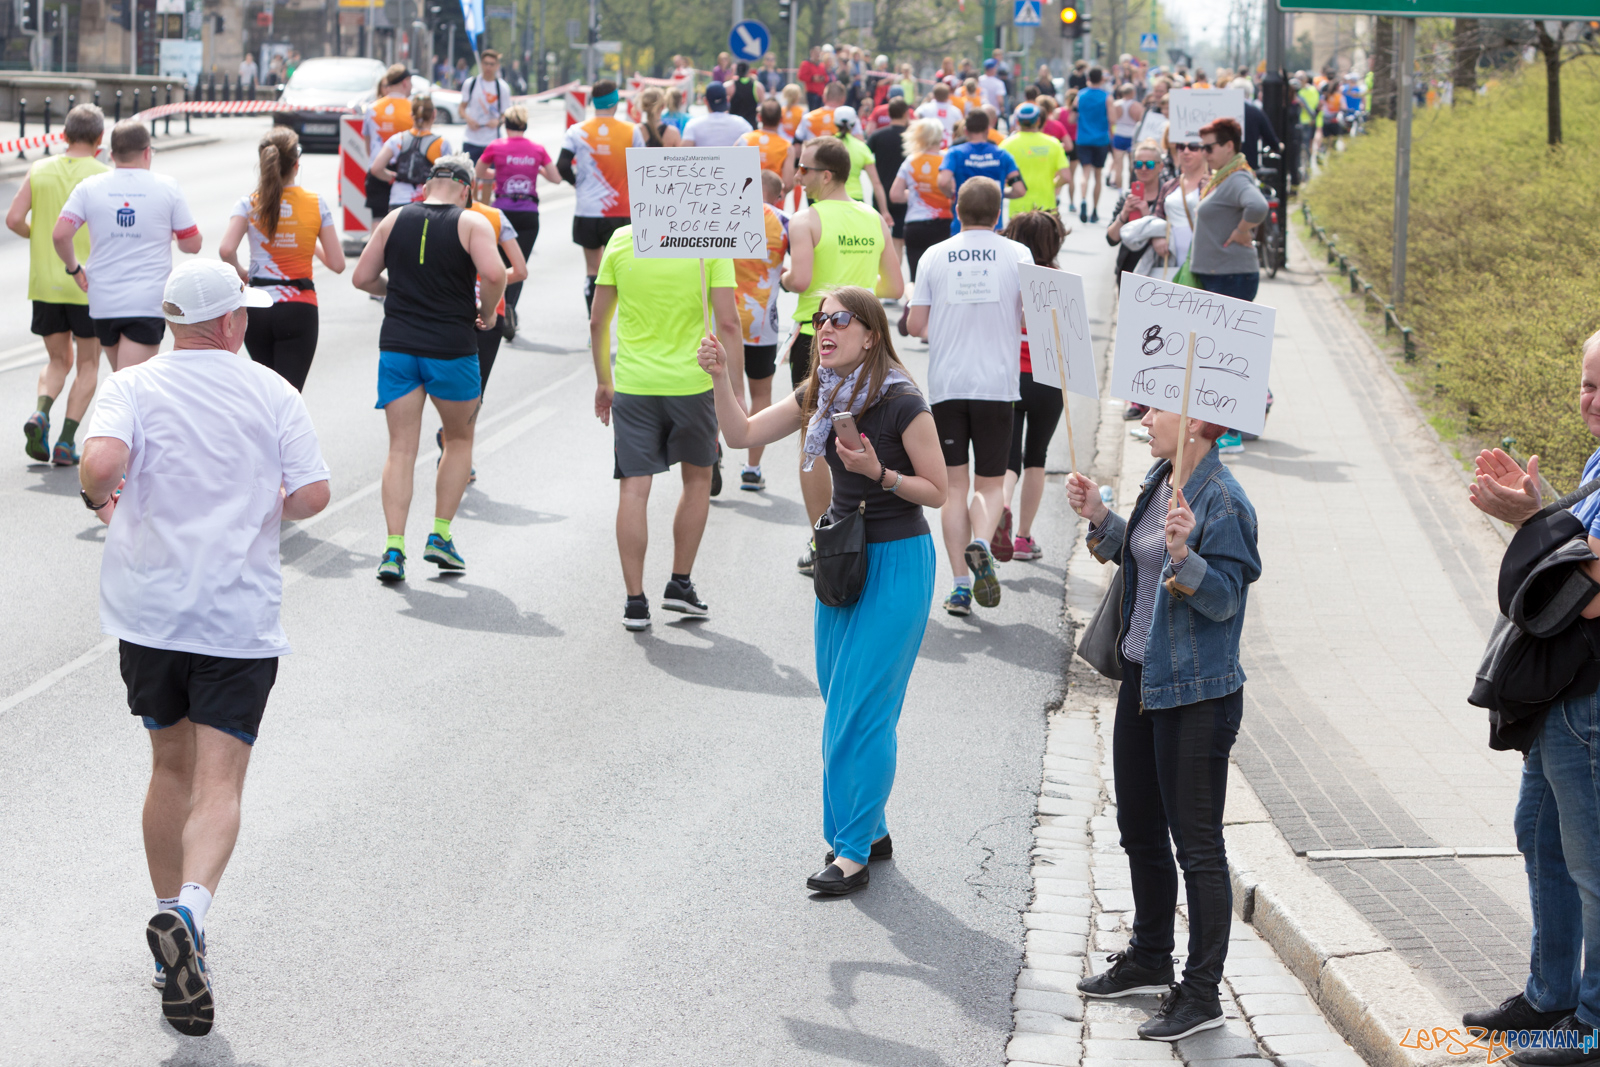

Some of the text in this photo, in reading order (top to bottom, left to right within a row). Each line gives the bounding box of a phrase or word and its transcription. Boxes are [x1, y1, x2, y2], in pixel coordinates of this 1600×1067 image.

[507, 155, 535, 166] Paula
[635, 163, 725, 186] JESTEŚCIE
[634, 203, 676, 218] PIWO
[731, 205, 750, 217] ZA
[660, 236, 736, 247] BRIDGESTONE
[838, 235, 875, 246] Makos
[948, 249, 996, 263] BORKI
[1164, 384, 1180, 399] co
